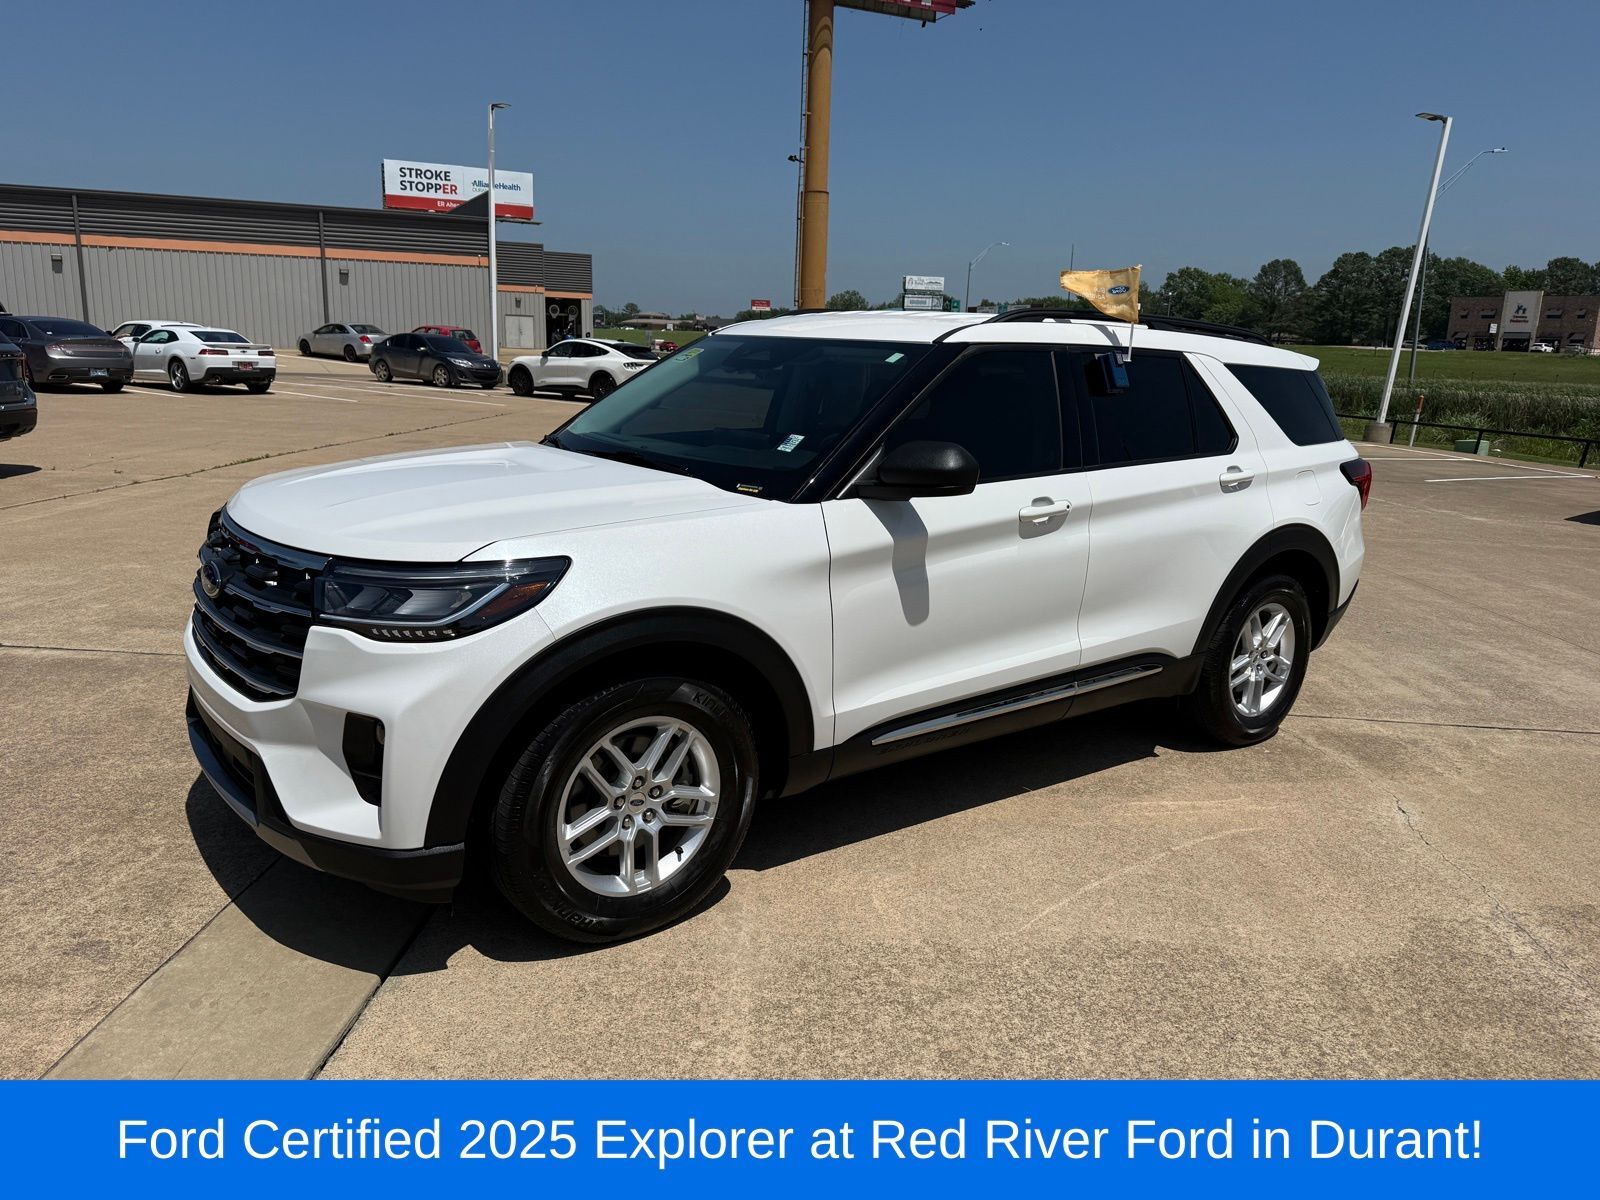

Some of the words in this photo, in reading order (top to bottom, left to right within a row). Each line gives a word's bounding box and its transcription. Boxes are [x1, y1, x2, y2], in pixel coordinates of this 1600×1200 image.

[399, 167, 451, 182] STROKE
[400, 180, 458, 195] STOPPER
[472, 180, 521, 192] AlliaeHealth
